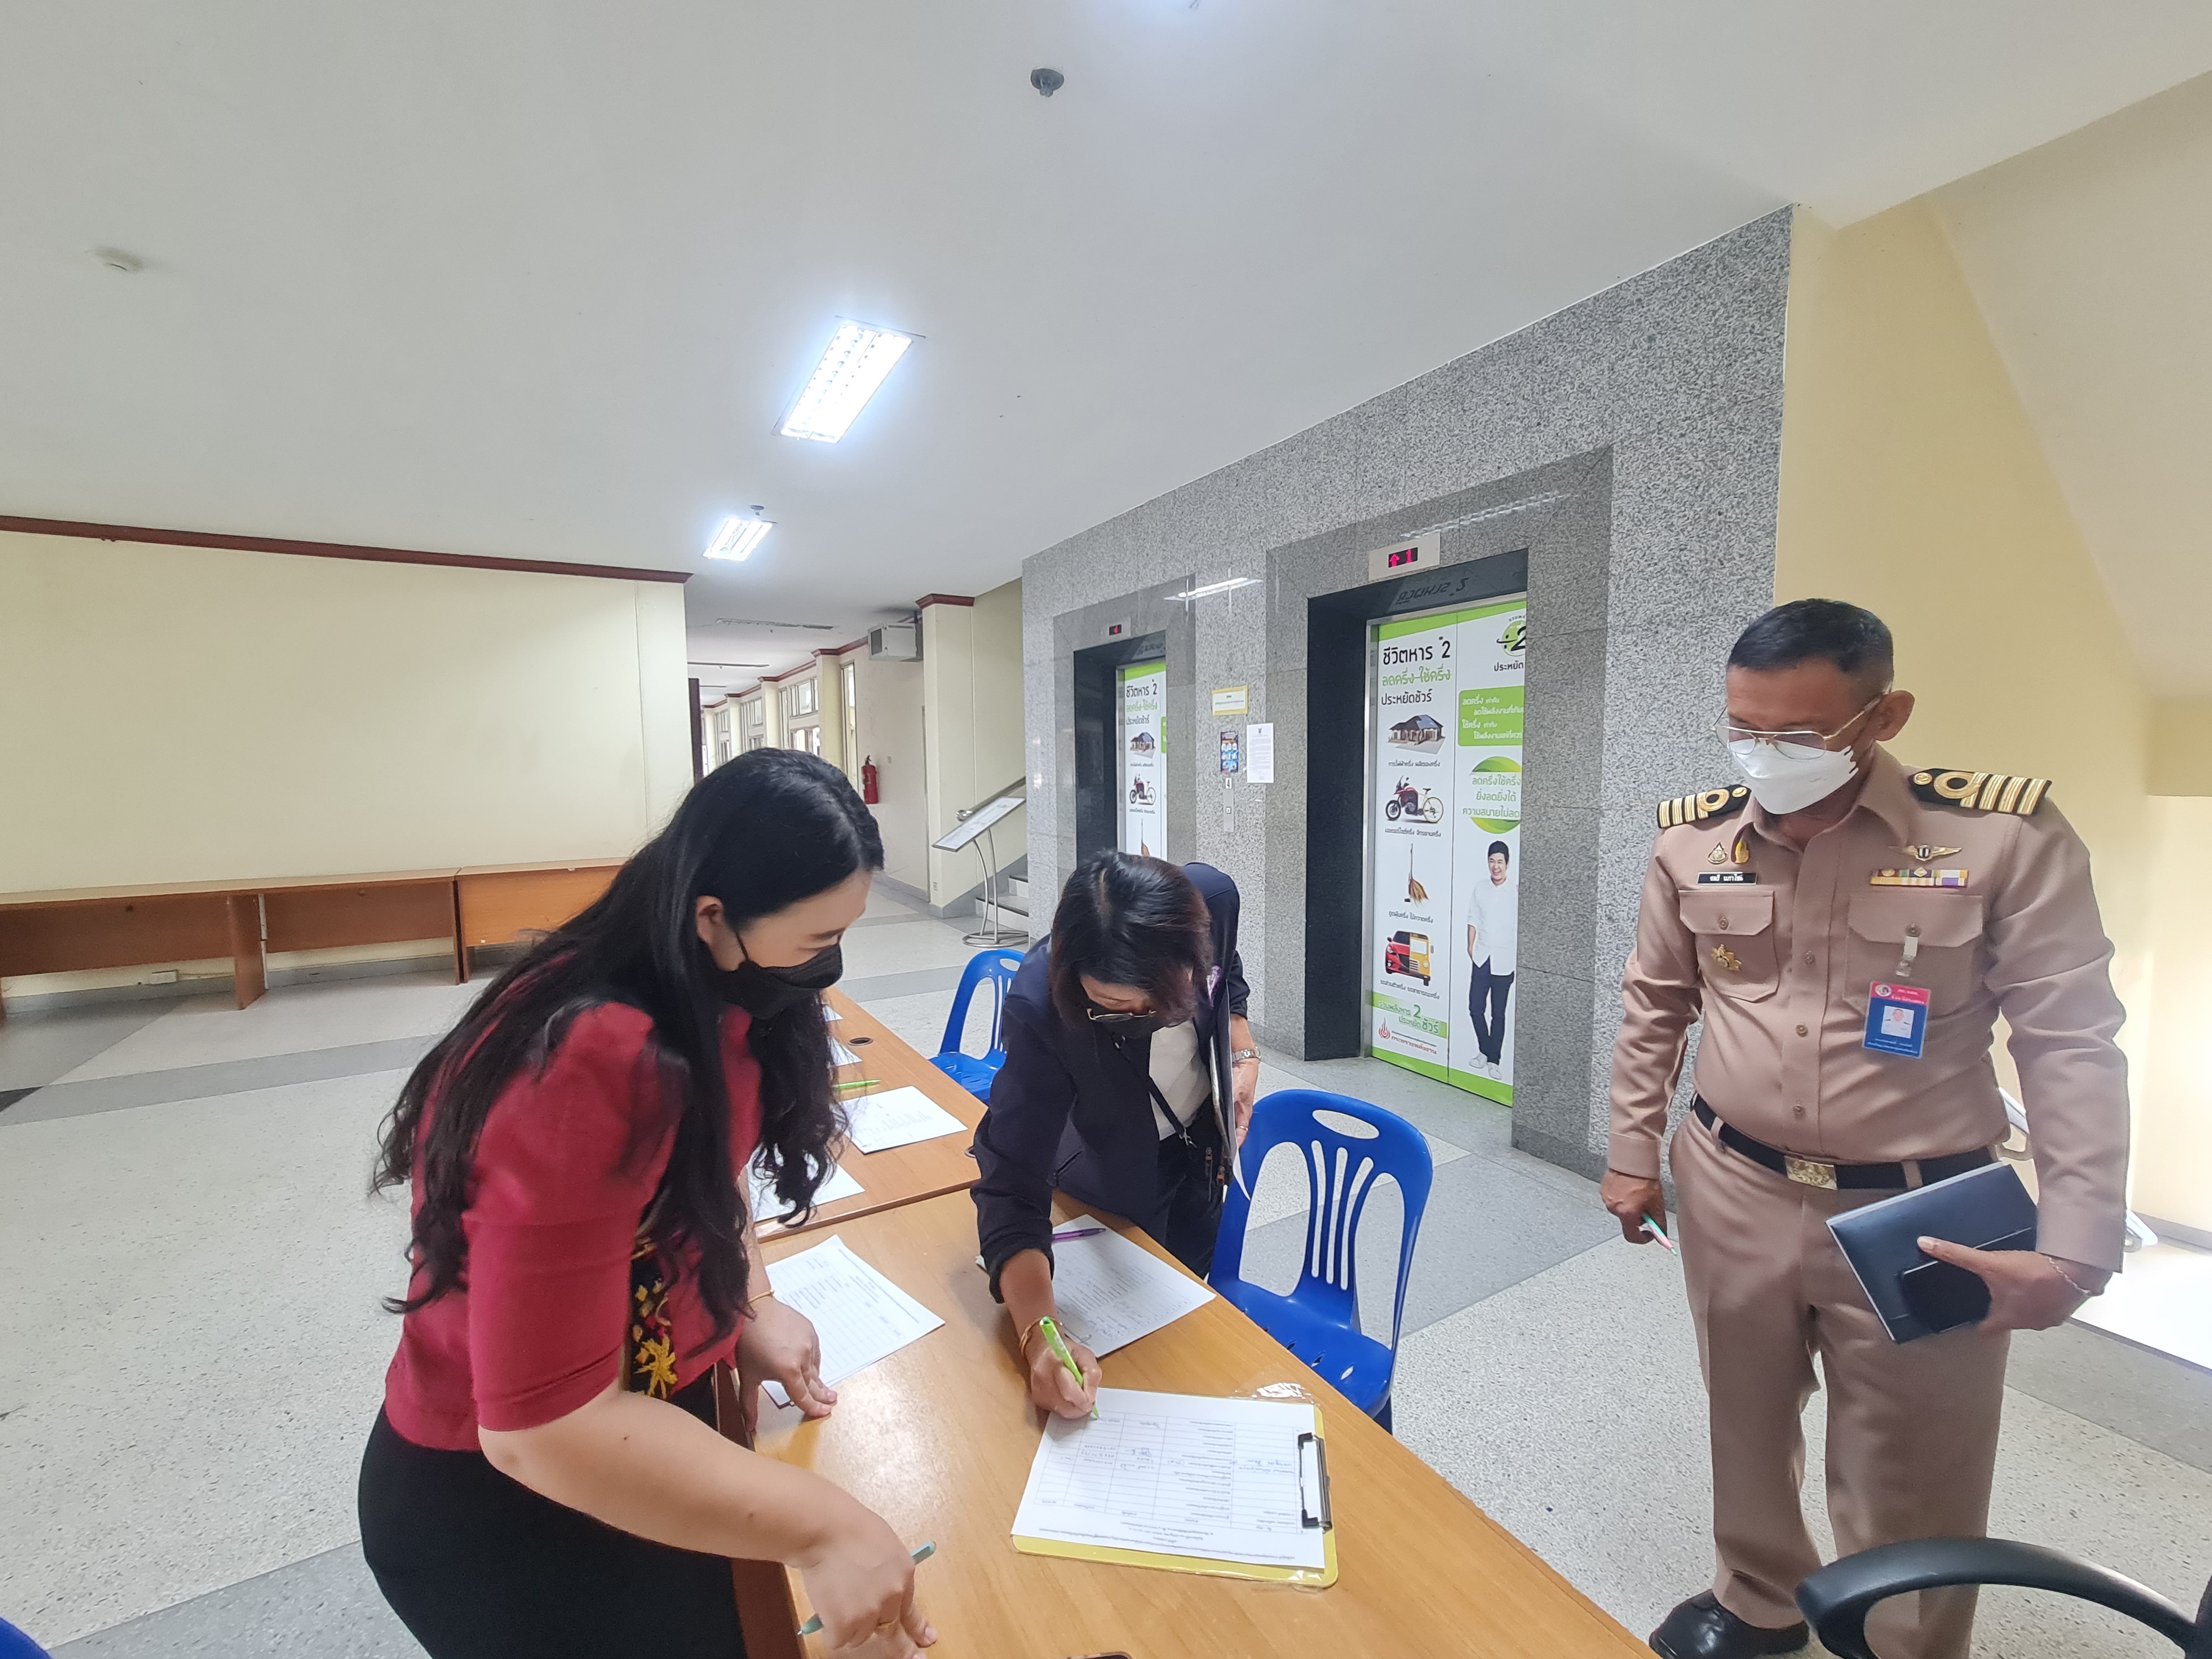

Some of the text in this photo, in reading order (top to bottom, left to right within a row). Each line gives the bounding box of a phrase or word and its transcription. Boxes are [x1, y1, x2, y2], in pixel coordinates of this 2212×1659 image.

[1383, 640, 1451, 665] ชีวิตหาร 2
[1494, 660, 1524, 671] ประหยัด
[1126, 683, 1157, 697] ชีวิตหาร 2
[1381, 688, 1433, 705] ประหยัดชัวร์
[1476, 788, 1516, 802] ยิ่งลดยิ่งได้
[1462, 805, 1520, 818] ความสบายไม่ลด
[1413, 1005, 1421, 1018] 2
[1422, 1018, 1439, 1033] ชัวร์
